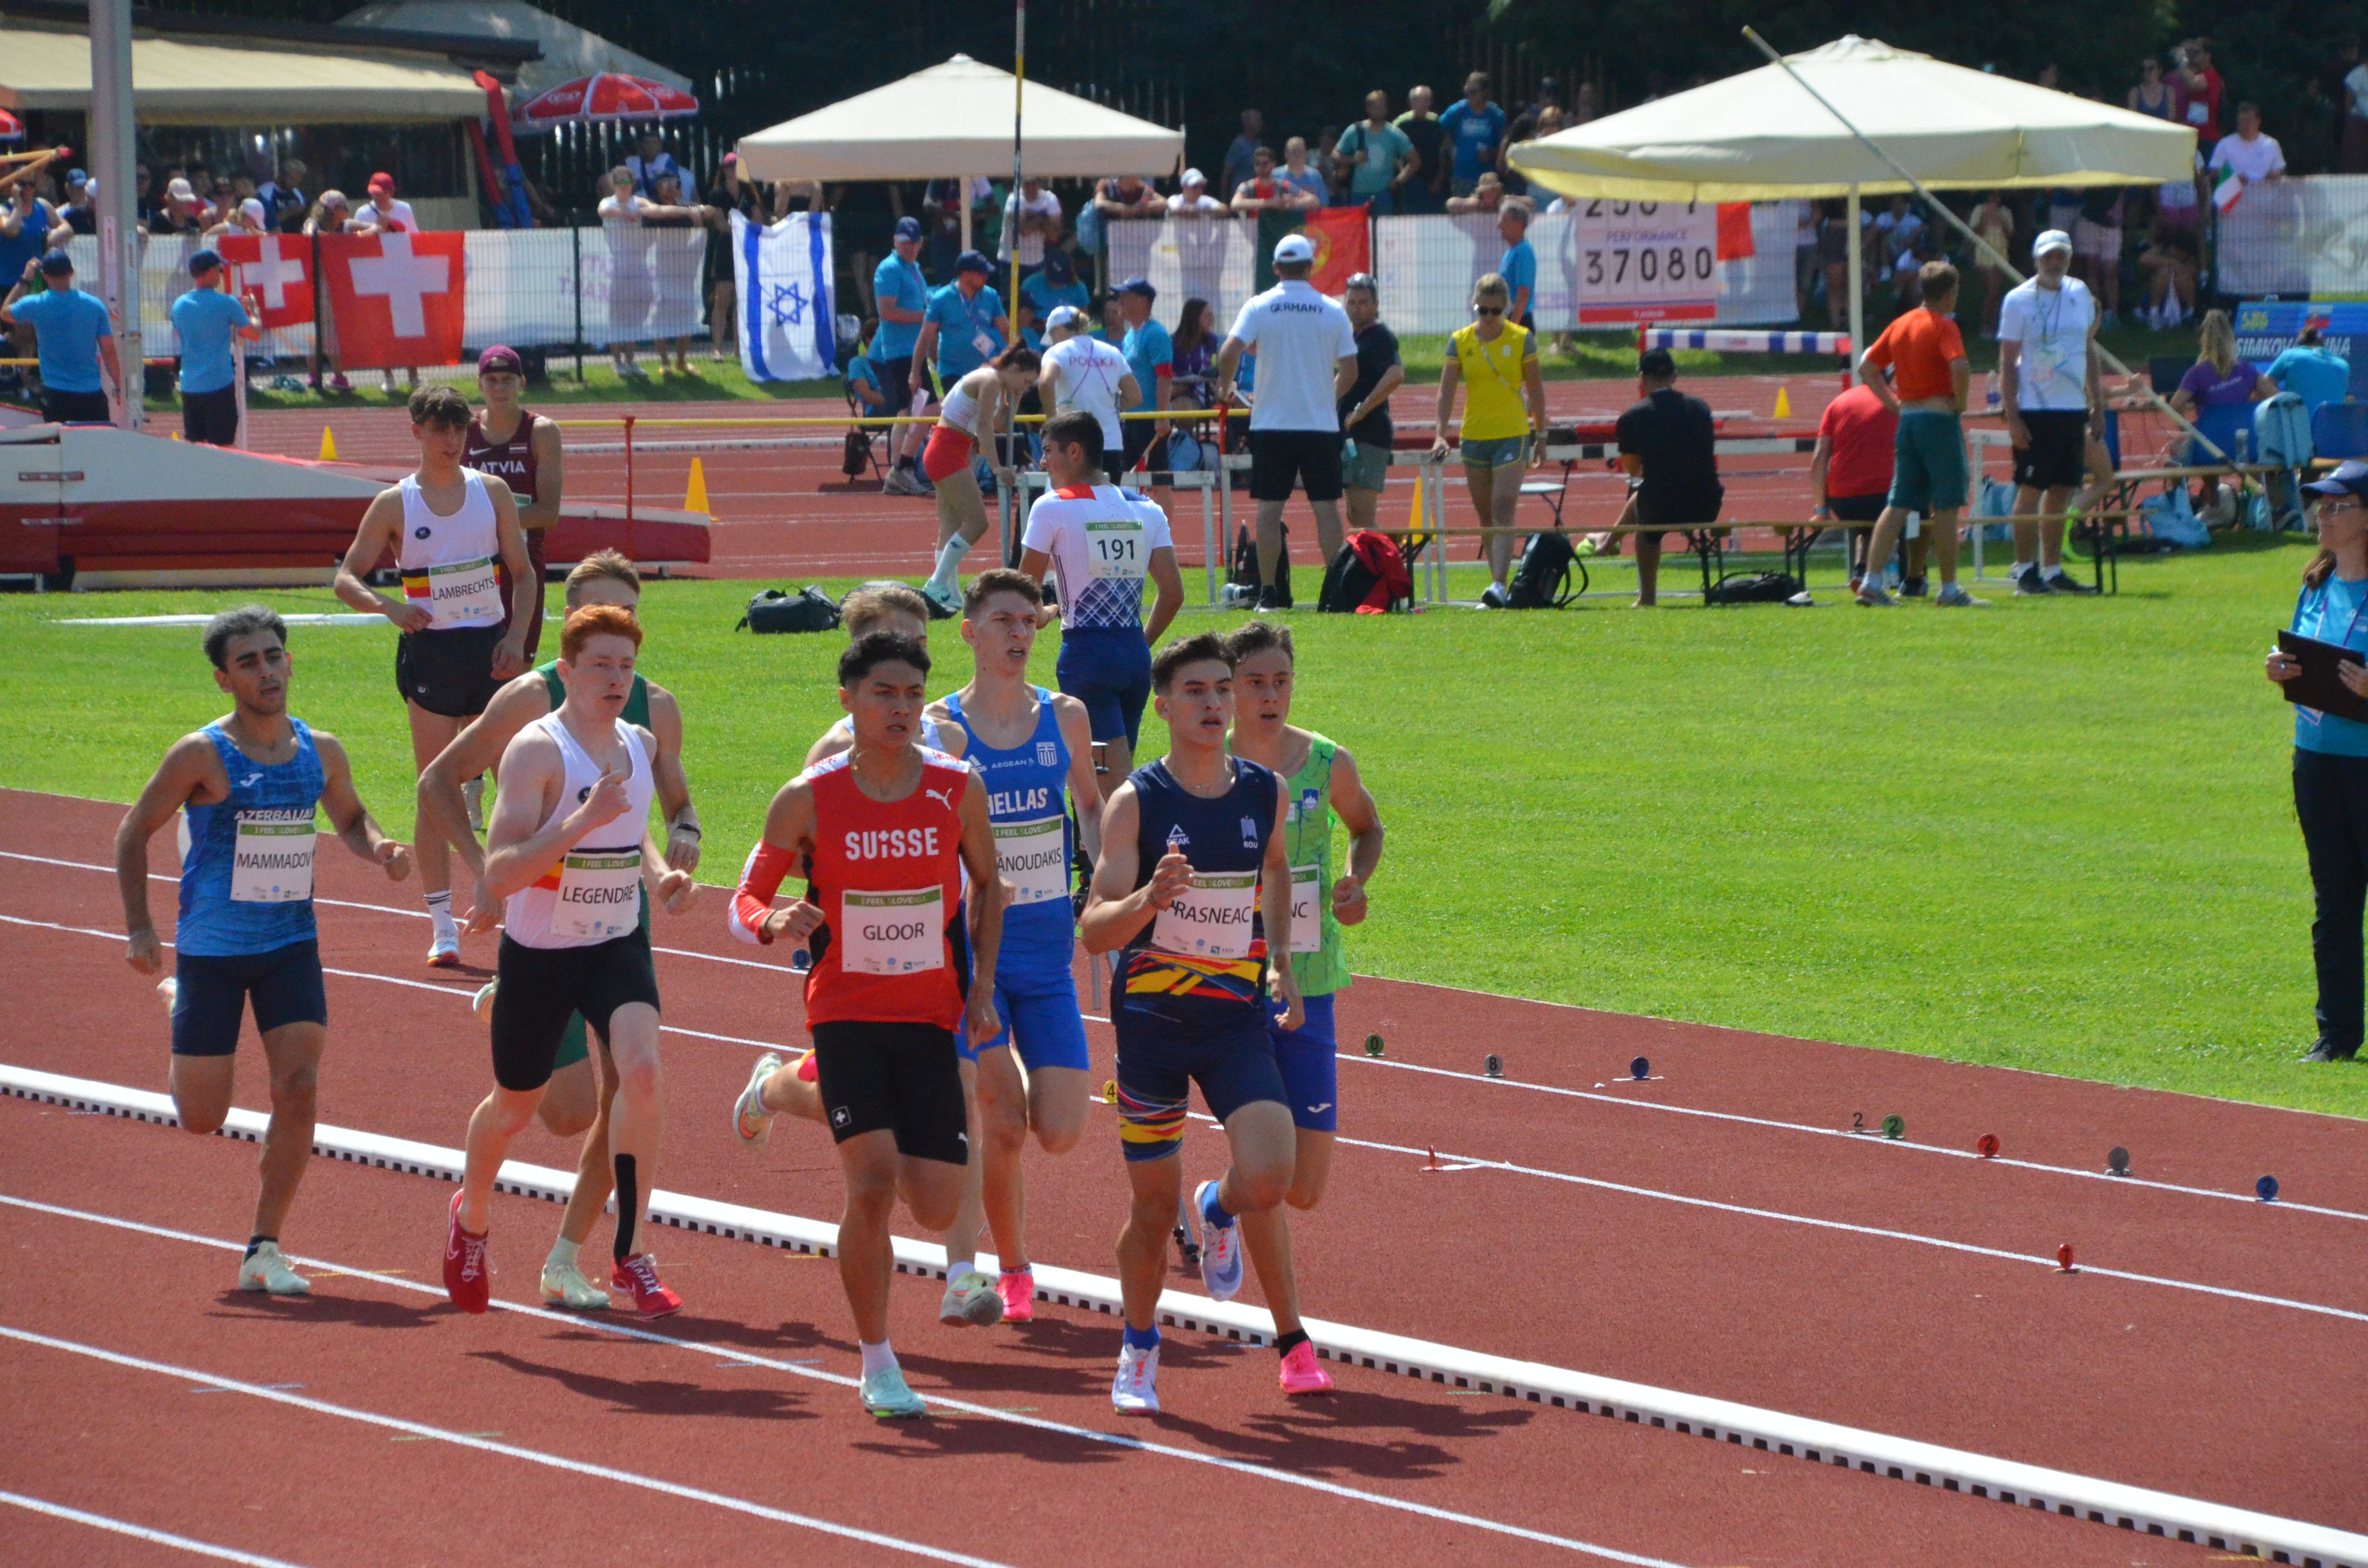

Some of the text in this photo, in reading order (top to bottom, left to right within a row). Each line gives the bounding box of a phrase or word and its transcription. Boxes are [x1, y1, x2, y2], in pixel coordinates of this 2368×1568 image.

[1607, 229, 1688, 242] PERFORMANCE
[1270, 302, 1323, 314] GERMANY
[2237, 337, 2299, 357] SIMKOV
[1069, 355, 1117, 368] POLSKA
[1097, 539, 1134, 560] 191
[432, 576, 495, 601] LAMBRECHTS
[991, 760, 1026, 769] AEGEAN
[236, 852, 312, 869] MAMMADOV
[998, 847, 1062, 872] ANOUDAKIS
[562, 884, 636, 904] LEGENDRE
[1292, 901, 1308, 919] NC
[863, 922, 925, 941] GLOOR
[1489, 1057, 1497, 1071] 8
[1107, 1084, 1115, 1097] 4
[1853, 1112, 1863, 1127] 2
[1887, 1118, 1899, 1133] 2
[1984, 1136, 1994, 1152] 2
